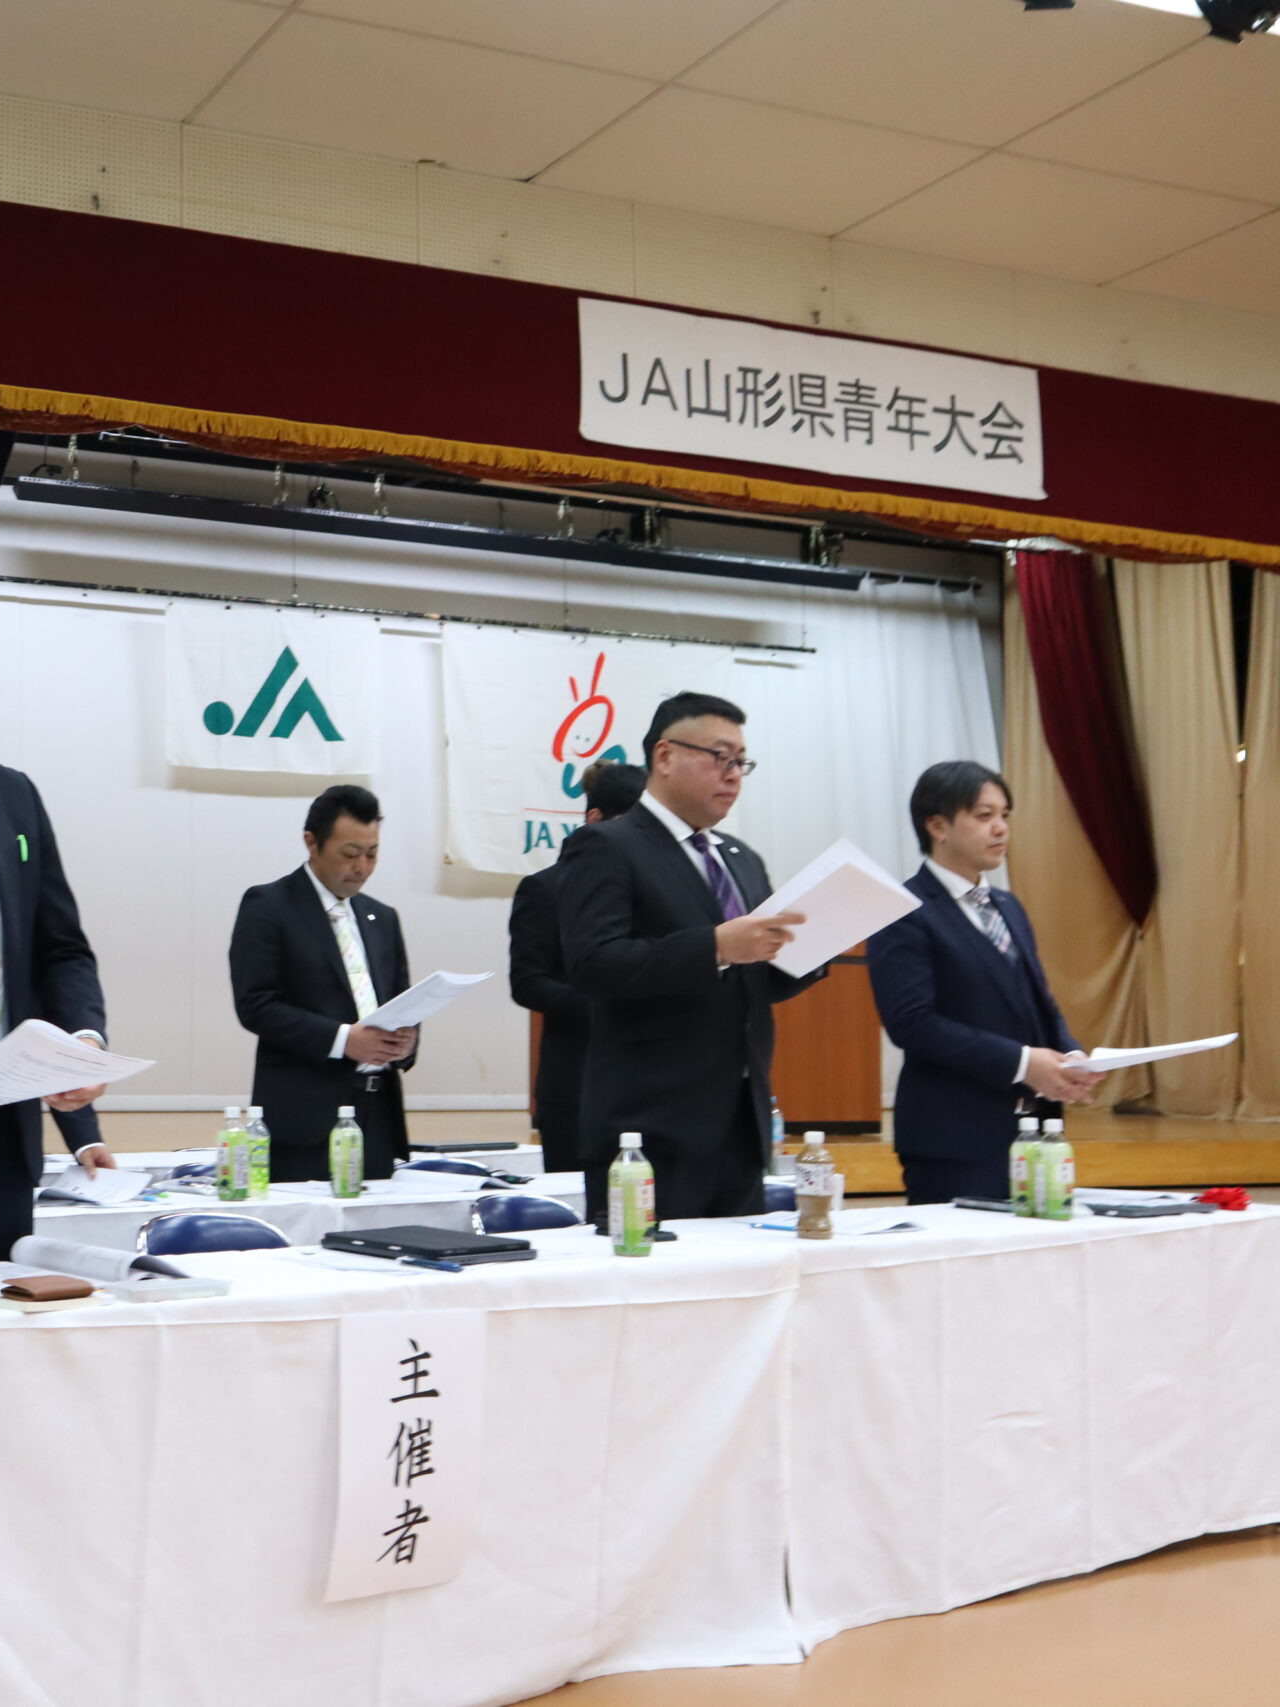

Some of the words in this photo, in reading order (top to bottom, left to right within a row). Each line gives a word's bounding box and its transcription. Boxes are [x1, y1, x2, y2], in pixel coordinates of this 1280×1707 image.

[598, 352, 1025, 464] JA山形県青年大会
[521, 820, 555, 855] JA
[375, 1338, 441, 1565] 主催者
